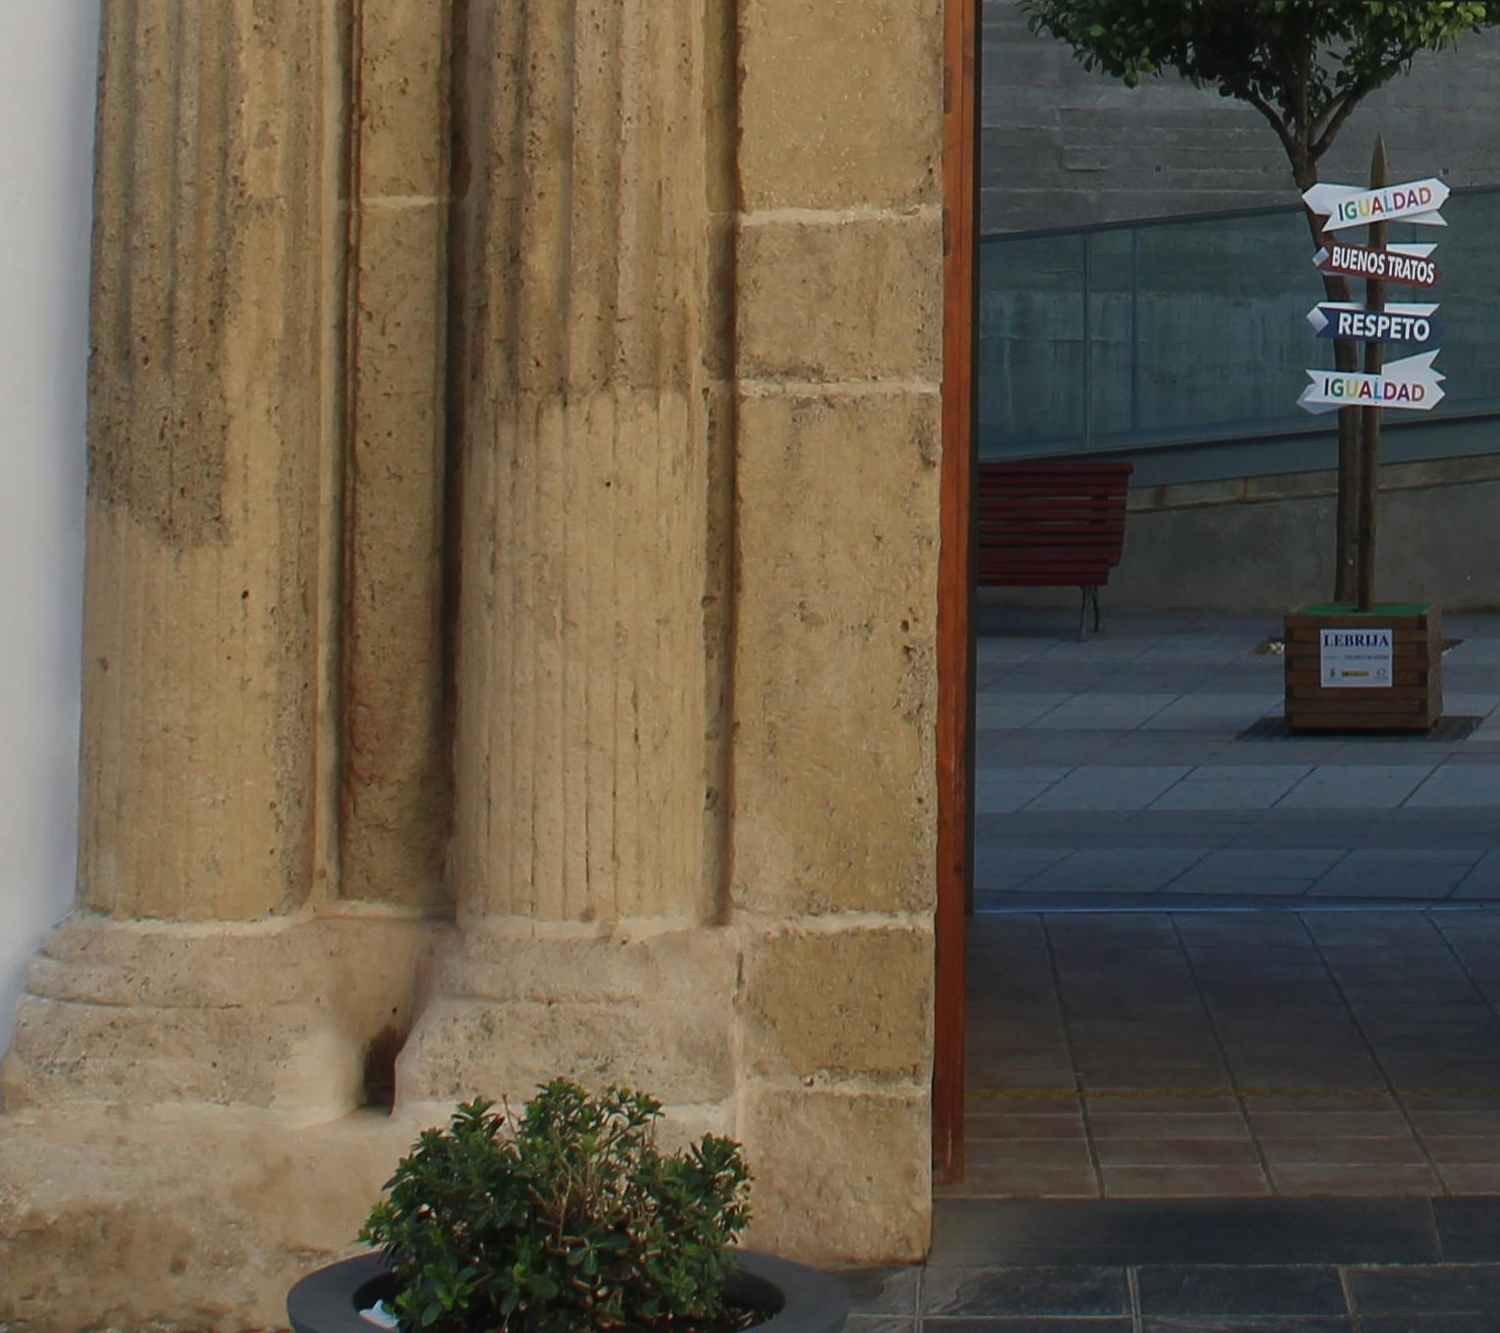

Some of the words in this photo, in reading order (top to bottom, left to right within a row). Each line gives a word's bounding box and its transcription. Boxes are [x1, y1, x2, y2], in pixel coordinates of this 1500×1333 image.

[1338, 186, 1432, 221] IGUALDAD
[1331, 245, 1385, 275] BUENOS
[1387, 254, 1435, 284] TRATOS
[1338, 312, 1430, 342] RESPETO
[1324, 377, 1425, 402] IGUALDAD
[1324, 634, 1389, 647] LEBRIJA
